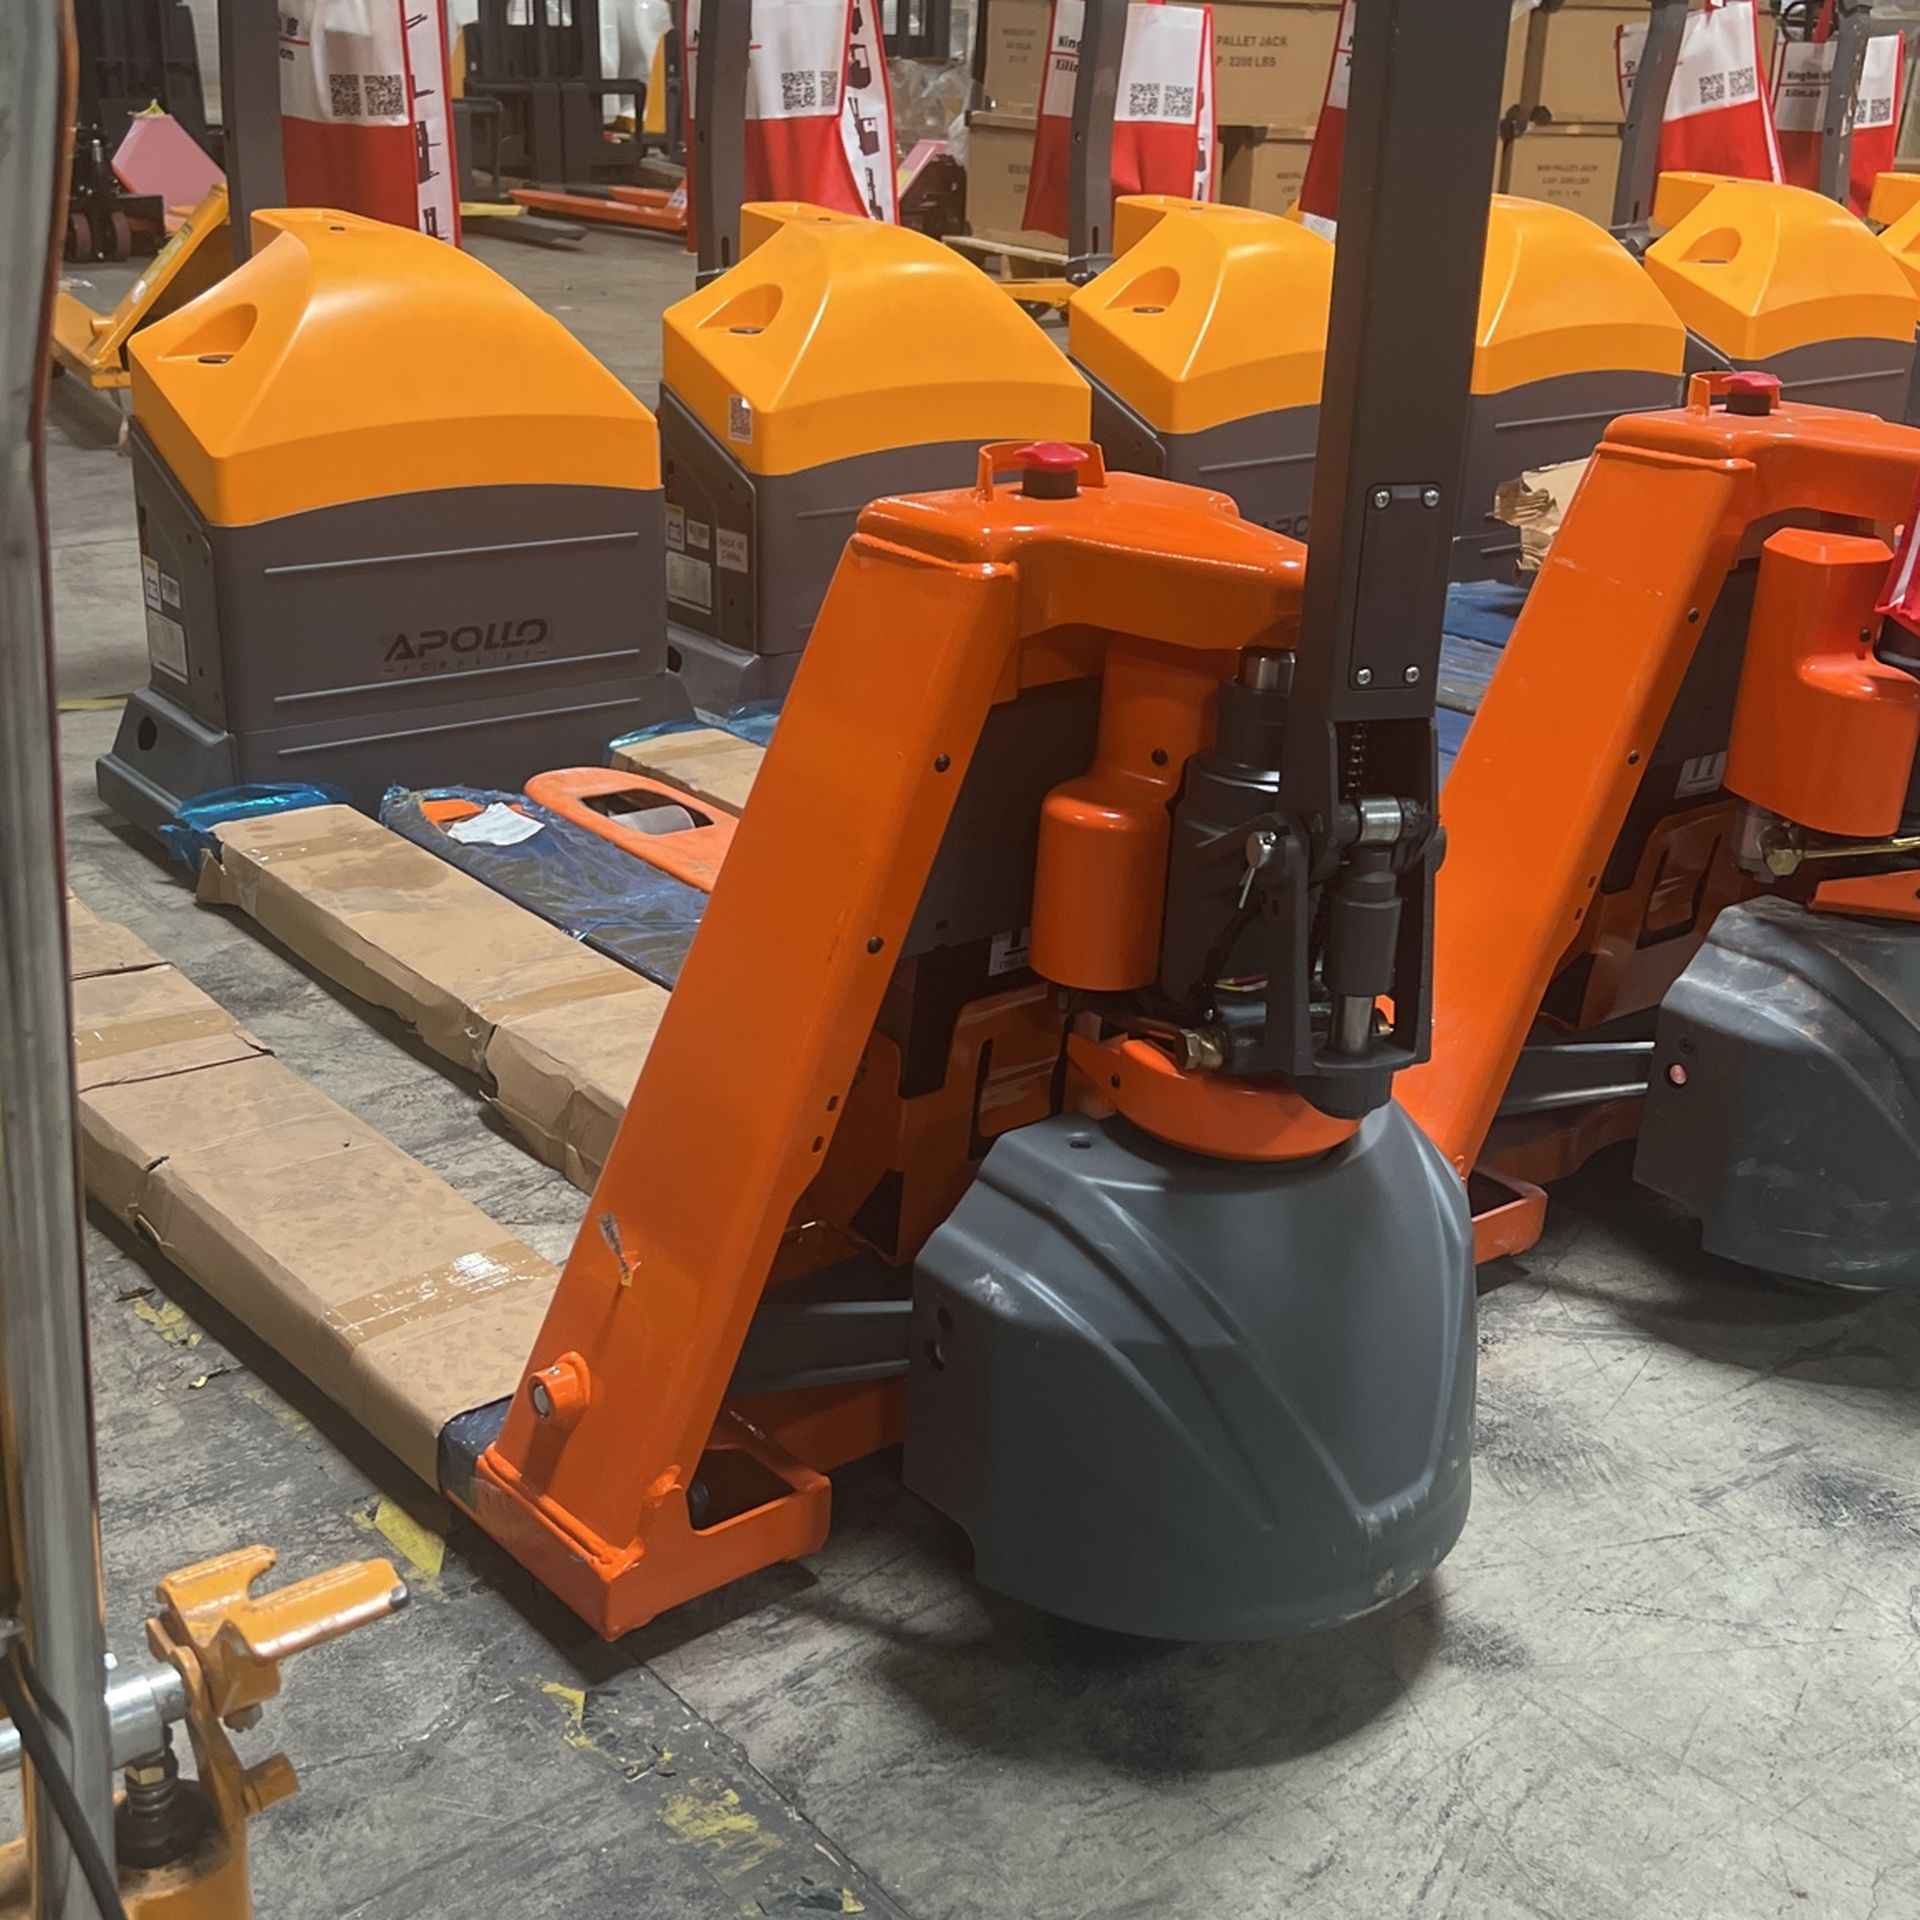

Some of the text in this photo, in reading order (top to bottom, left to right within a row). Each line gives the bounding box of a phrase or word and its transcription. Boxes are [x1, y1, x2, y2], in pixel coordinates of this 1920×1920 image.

[1215, 35, 1288, 47] PALLET JACK
[384, 619, 548, 662] APOLLO
